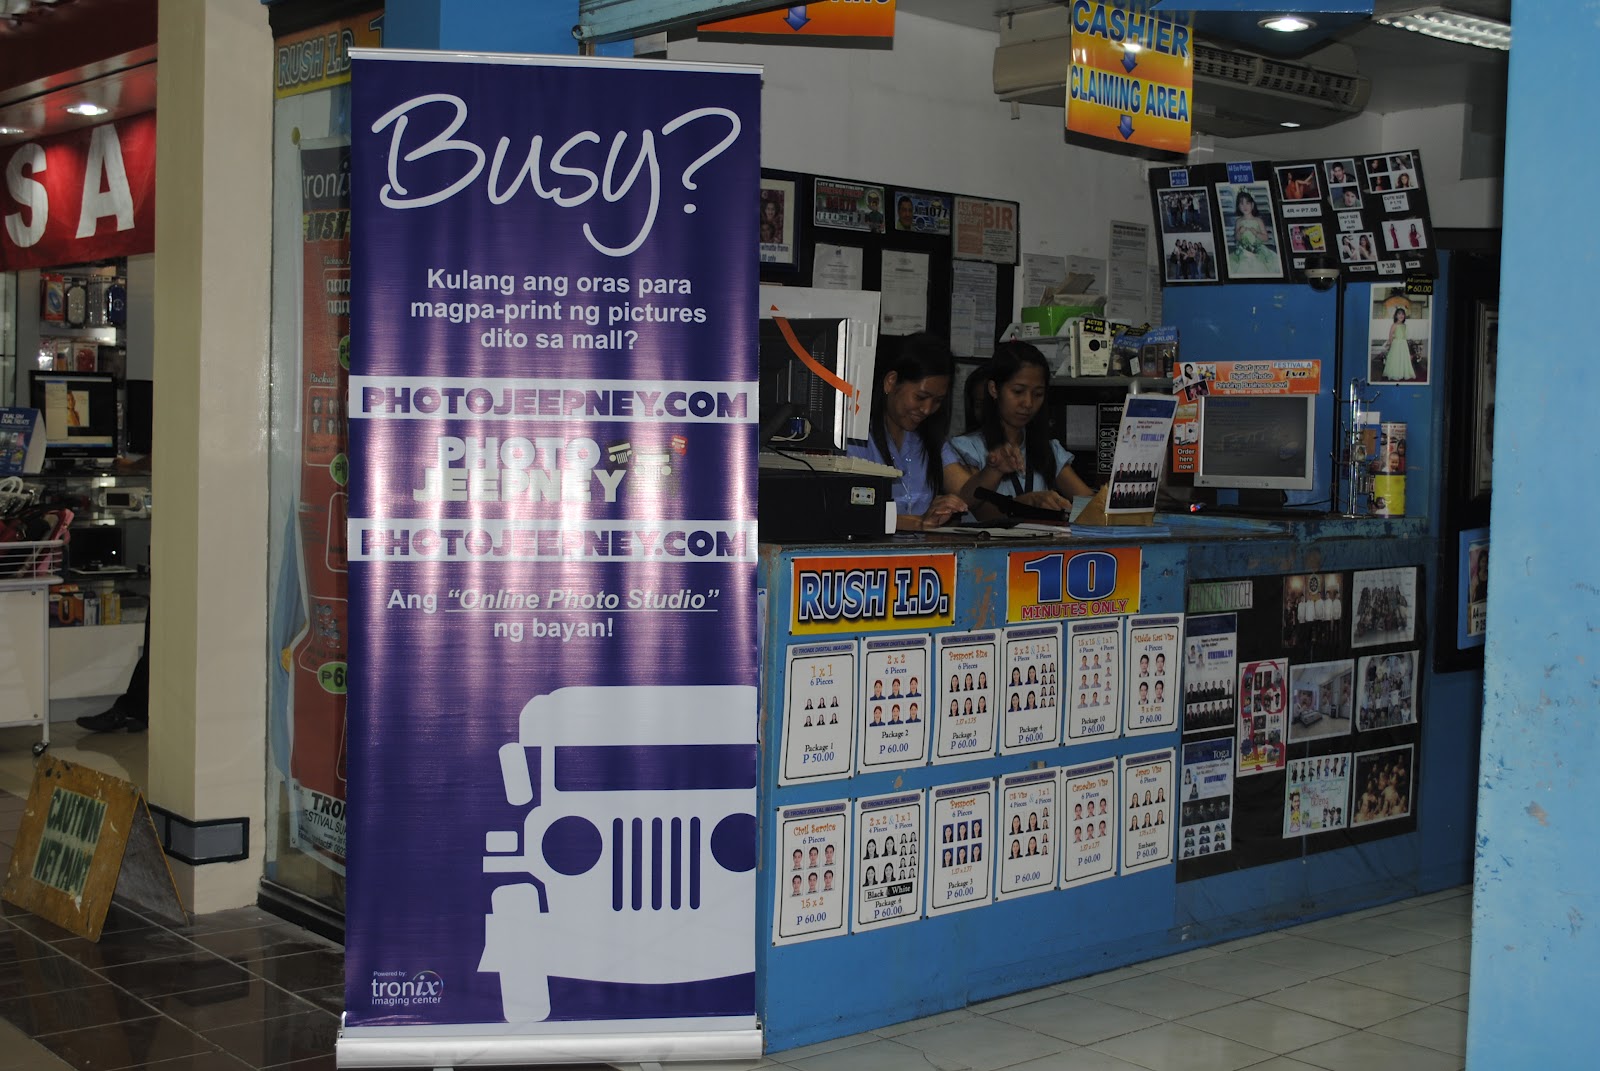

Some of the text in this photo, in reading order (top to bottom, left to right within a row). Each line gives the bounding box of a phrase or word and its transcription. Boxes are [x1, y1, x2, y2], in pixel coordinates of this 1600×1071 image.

[1072, 0, 1190, 59] CASHIER
[278, 38, 324, 87] RUSH
[1071, 65, 1189, 122] CLAIMING AREA
[372, 93, 741, 257] Busy?
[984, 205, 1013, 230] BIR
[427, 269, 692, 299] Kulang ang oras para
[410, 299, 708, 327] magpa-print ng pictures
[480, 328, 640, 350] dito sa mall?
[361, 385, 749, 419] PHOTOJEEPNEY.COM
[437, 436, 601, 471] PHOTO
[412, 468, 627, 503] JEEPNEY
[360, 528, 749, 558] PHOTOJEEPNEY.COM
[1022, 550, 1118, 604] 10
[799, 566, 950, 621] RUSH I.D.
[388, 589, 437, 615] Ang
[547, 590, 620, 610] Photo
[1021, 600, 1128, 620] MINUTES ONLY
[494, 617, 614, 643] ng bayan!
[887, 654, 906, 664] 2 2
[816, 678, 833, 686] Pieces
[1146, 714, 1161, 722] 60.00
[881, 731, 904, 739] Package
[1088, 724, 1104, 733] 60.00
[958, 739, 977, 748] 60.00
[1026, 733, 1044, 742] 60.00
[805, 744, 829, 753] Package
[879, 742, 909, 754] P 60.00
[803, 751, 834, 764] P 50.00
[793, 823, 836, 836] Civil Service
[808, 836, 825, 844] Pieces
[1084, 853, 1101, 864] 60.00
[1143, 848, 1158, 858] 60.00
[1022, 871, 1040, 882] 60.00
[948, 880, 969, 889] Package
[867, 886, 911, 900] Black White
[954, 887, 974, 897] 60.00
[875, 900, 896, 908] Package
[881, 906, 903, 917] 60.00
[796, 912, 827, 925] P 60.00
[373, 970, 398, 978] Powered
[371, 975, 440, 998] tronix
[372, 996, 442, 1006] imaging center
